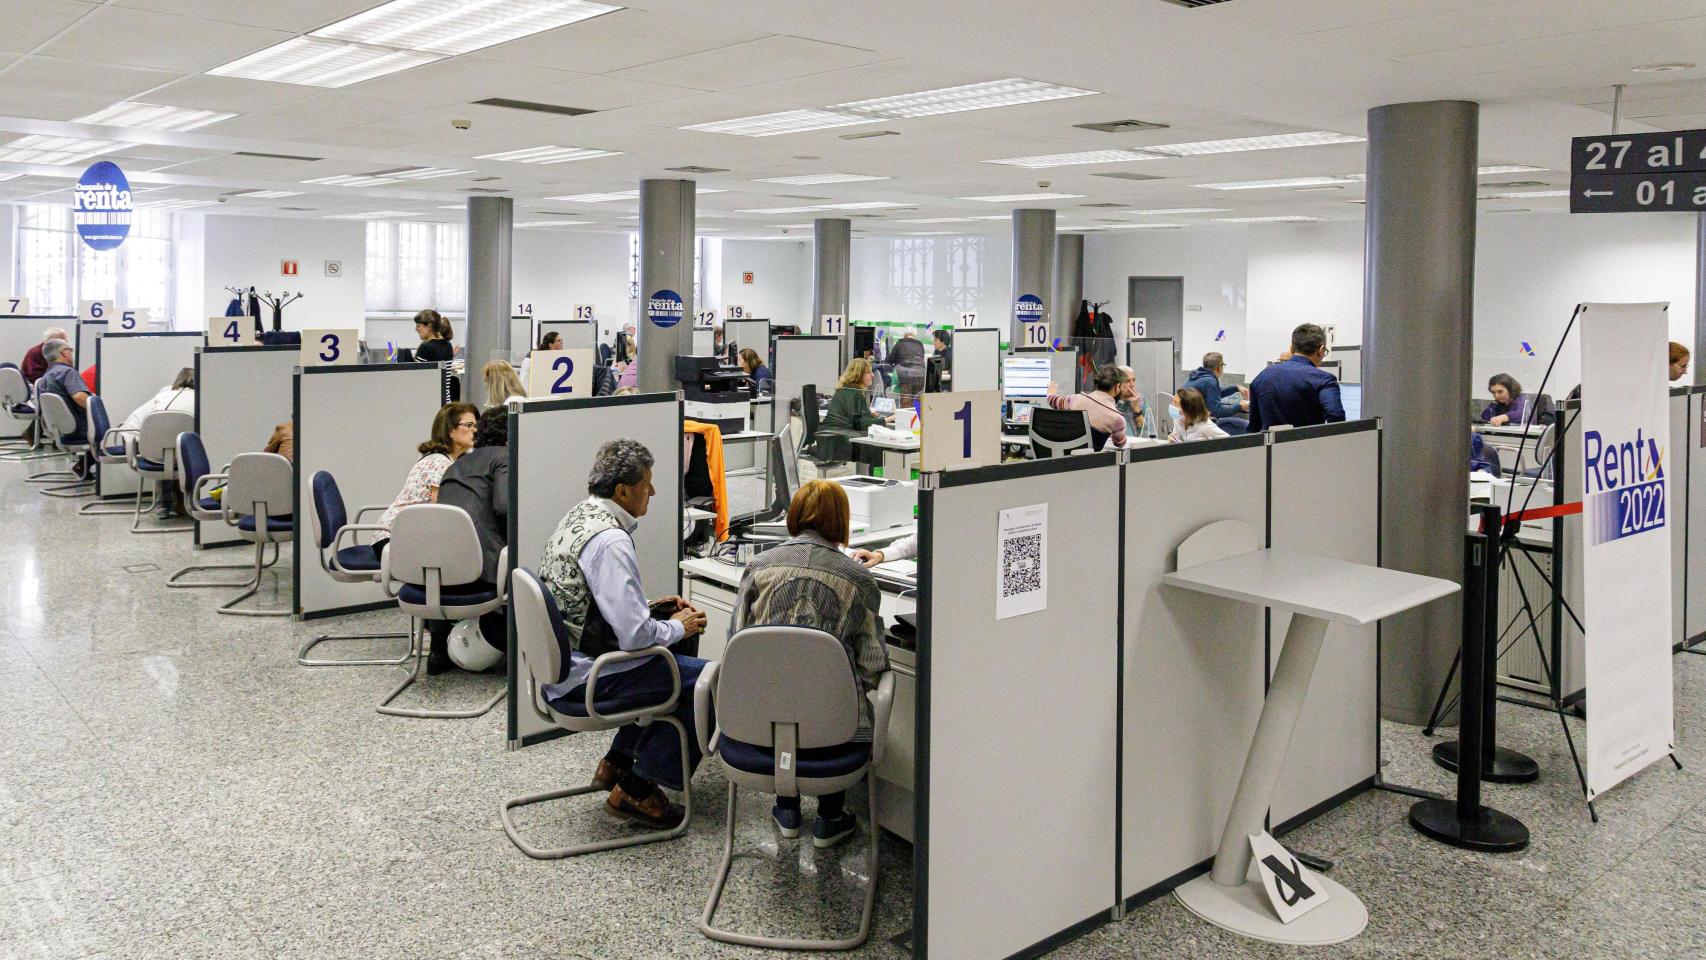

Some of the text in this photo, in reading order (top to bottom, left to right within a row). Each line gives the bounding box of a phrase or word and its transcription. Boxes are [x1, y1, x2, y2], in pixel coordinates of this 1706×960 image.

[1585, 140, 1632, 170] 27
[1647, 137, 1683, 167] al
[74, 185, 134, 210] renta
[1636, 180, 1674, 205] 01
[9, 300, 20, 313] 7
[91, 302, 103, 318] 6
[518, 303, 532, 315] 14
[577, 306, 592, 319] 13
[648, 300, 683, 311] renta
[730, 306, 742, 318] 19
[1015, 301, 1043, 311] renta
[121, 311, 136, 330] 5
[700, 312, 714, 326] 12
[826, 317, 841, 333] 11
[962, 313, 975, 327] 17
[223, 320, 241, 343] 4
[1028, 324, 1047, 344] 10
[1131, 320, 1144, 336] 16
[319, 334, 340, 362] 3
[551, 356, 574, 394] 2
[954, 401, 971, 458] 1
[1620, 483, 1664, 534] 2022
